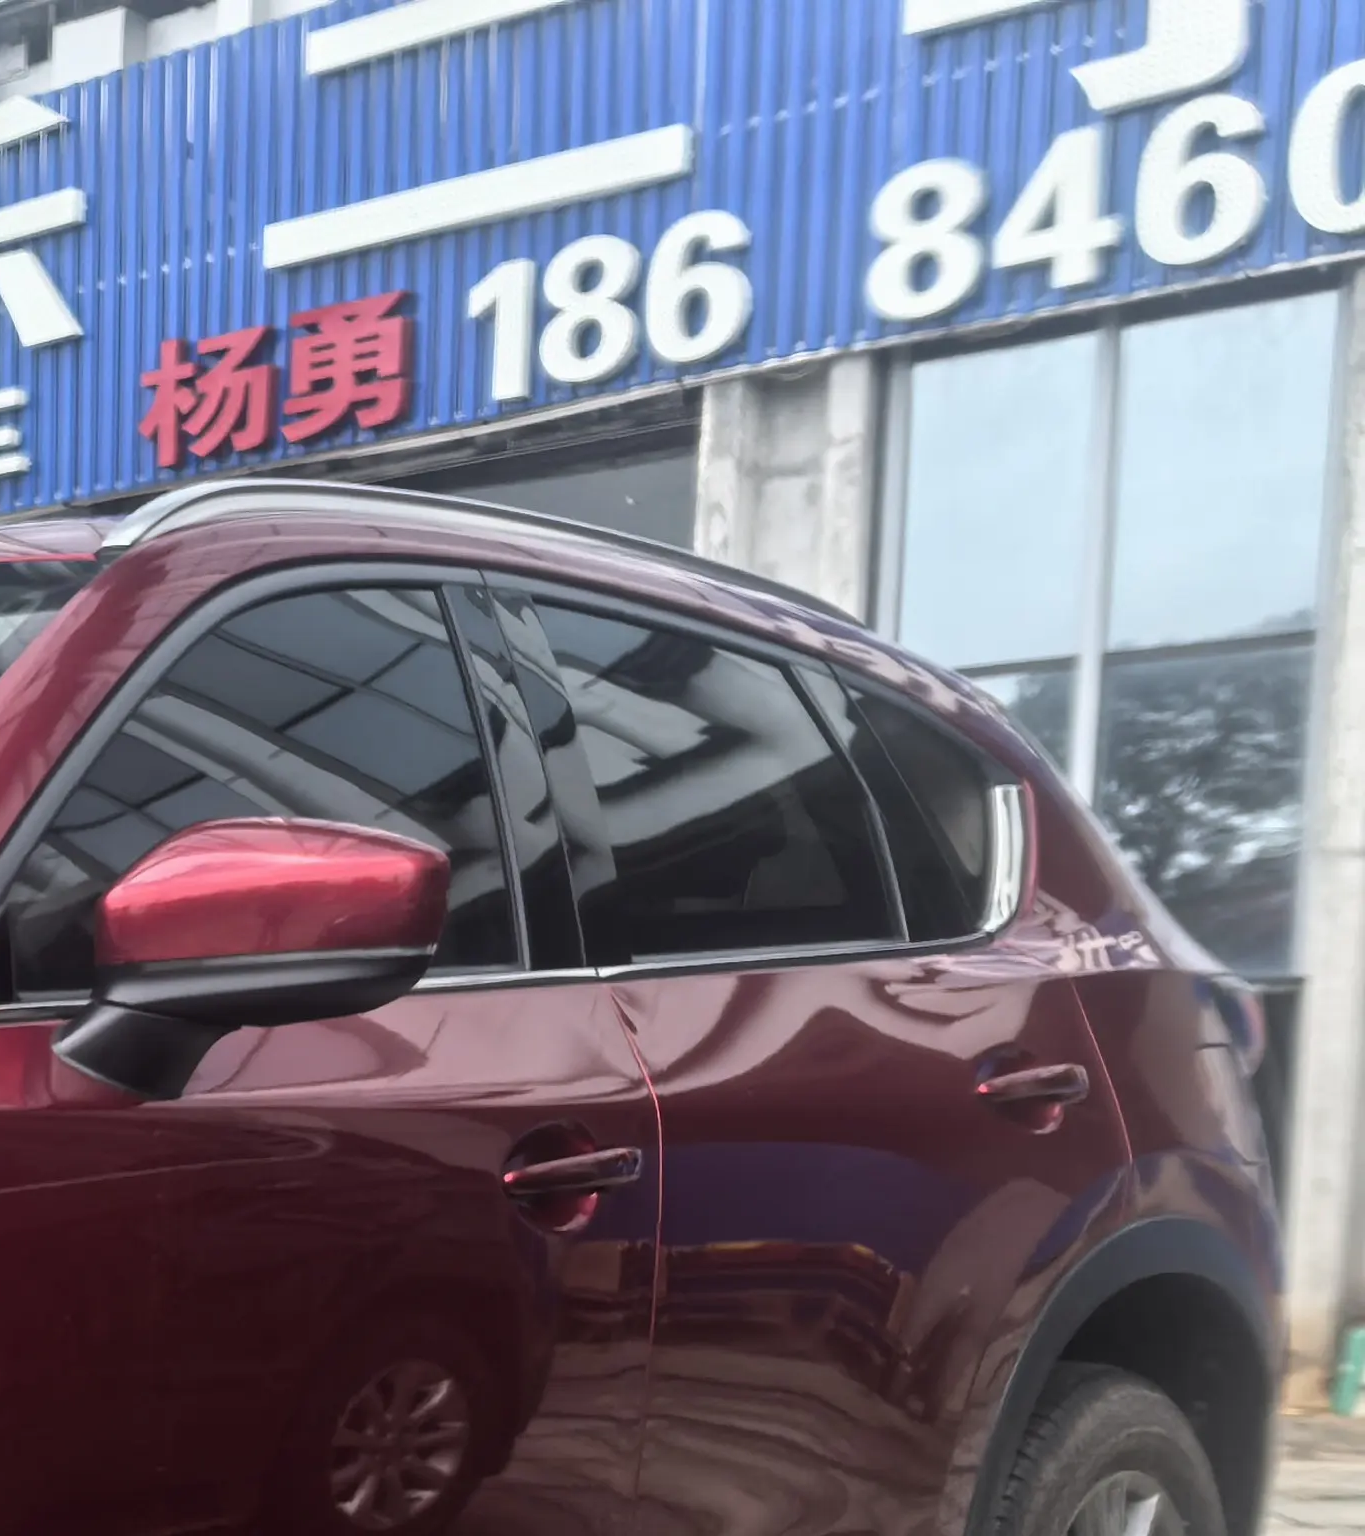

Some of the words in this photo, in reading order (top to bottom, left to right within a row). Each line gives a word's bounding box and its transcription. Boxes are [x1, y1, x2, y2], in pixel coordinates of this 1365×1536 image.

[138, 290, 414, 468] 杨勇
[468, 210, 754, 401] 186
[863, 58, 1365, 321] 8460
